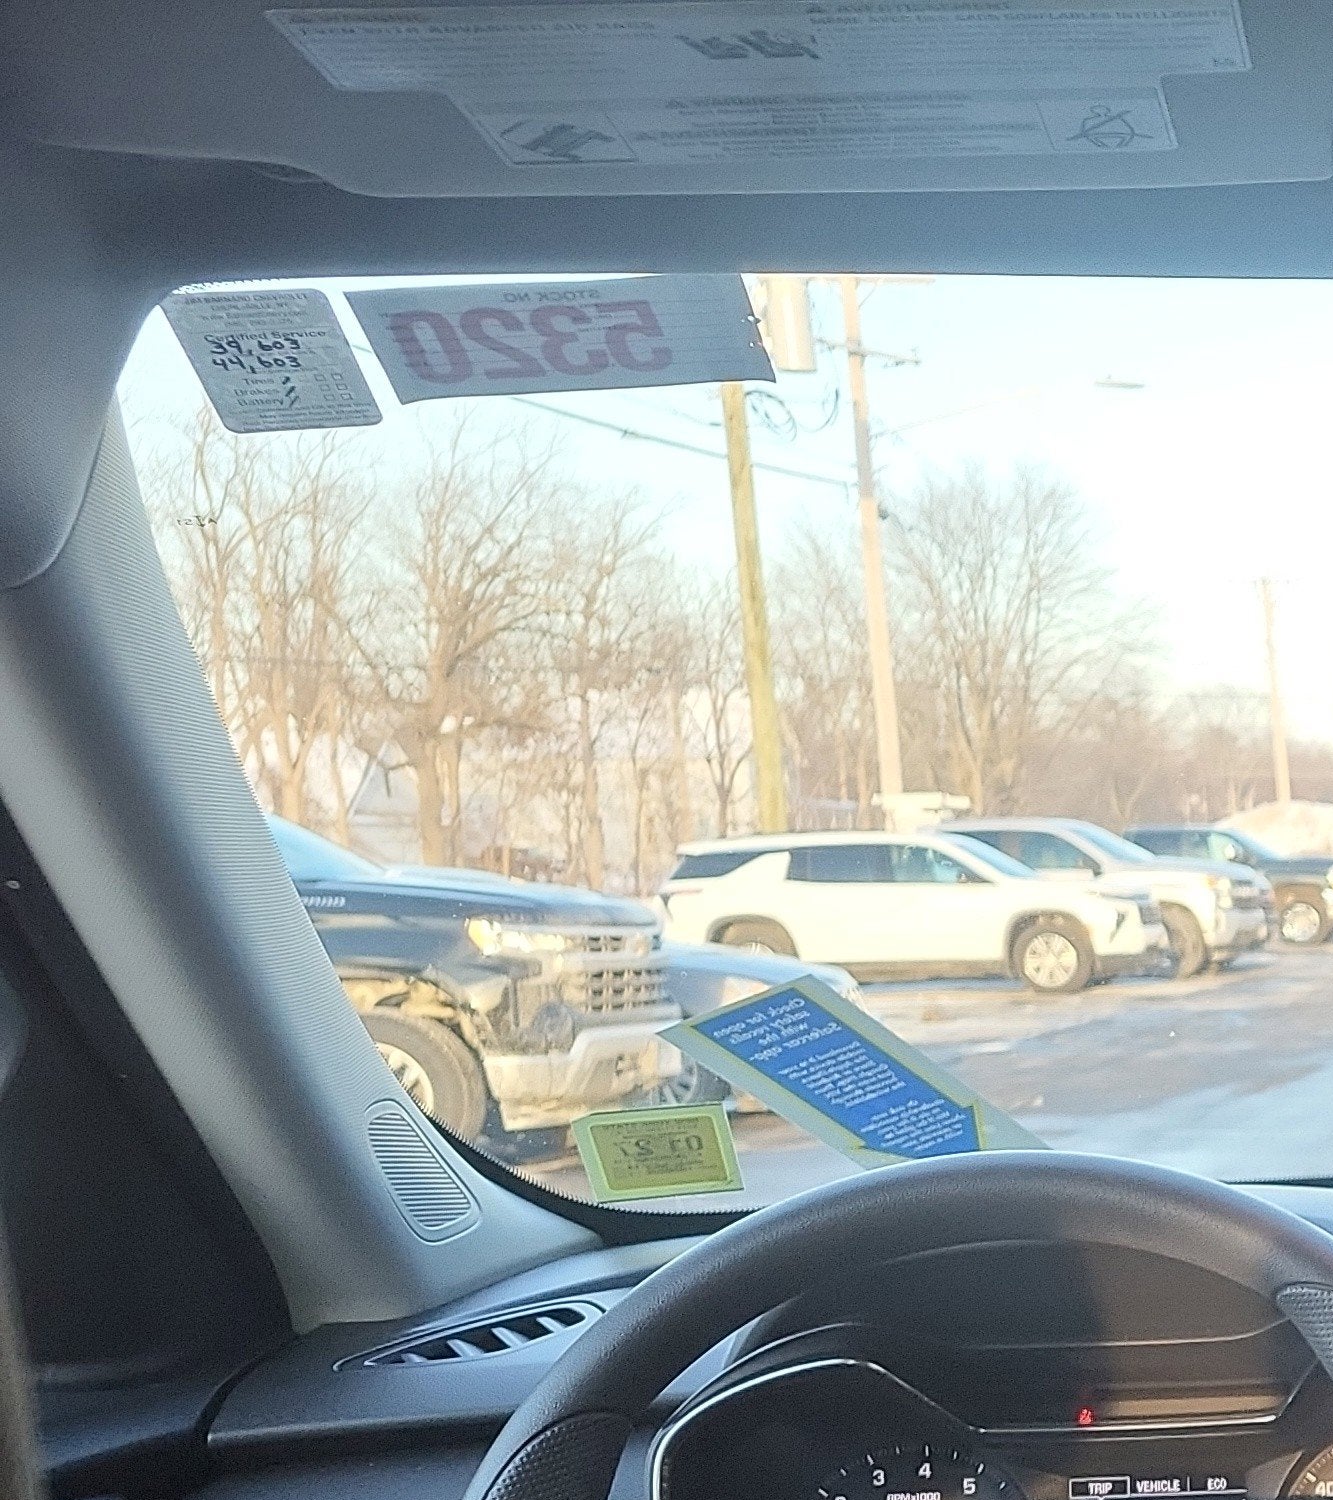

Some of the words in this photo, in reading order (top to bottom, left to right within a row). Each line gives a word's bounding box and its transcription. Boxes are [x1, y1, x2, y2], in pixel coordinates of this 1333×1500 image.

[270, 330, 326, 339] Service
[210, 337, 301, 356] 39,603
[211, 355, 302, 374] 44,603
[872, 1469, 885, 1486] 3
[918, 1461, 932, 1480] 4
[962, 1477, 976, 1495] 5
[1088, 1482, 1113, 1496] TRIP
[1136, 1478, 1181, 1494] VEHICLE
[1206, 1477, 1227, 1491] ECO
